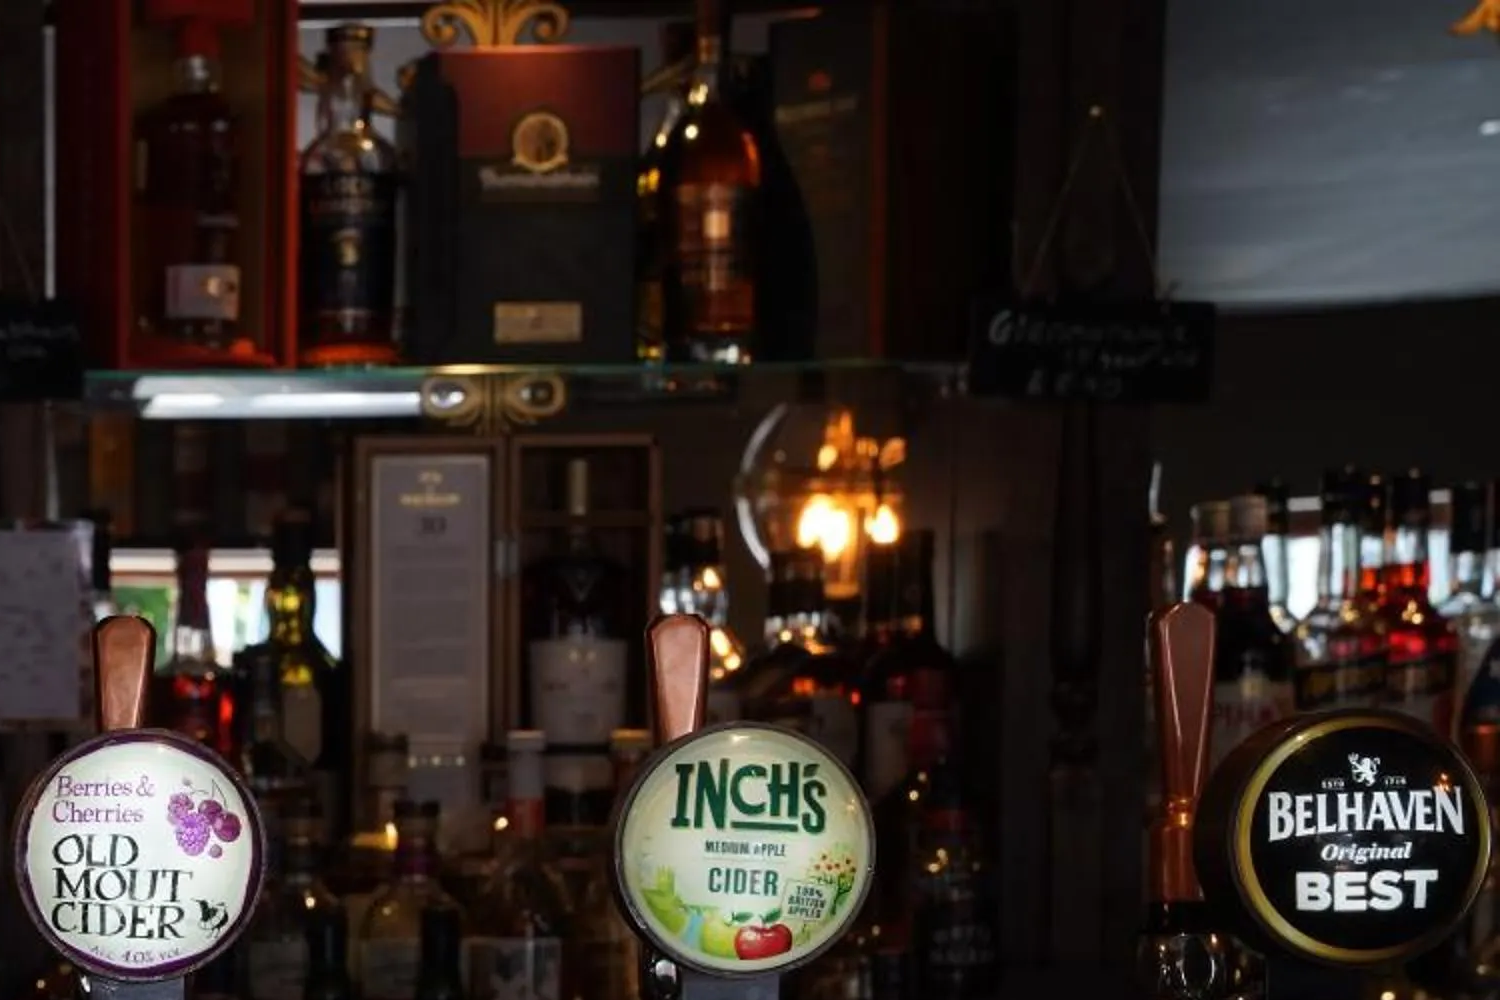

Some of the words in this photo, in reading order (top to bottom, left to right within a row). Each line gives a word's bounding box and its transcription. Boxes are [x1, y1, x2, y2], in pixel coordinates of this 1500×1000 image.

[57, 775, 133, 798] Berries
[135, 775, 156, 798] &
[52, 799, 145, 824] Cherries
[1268, 785, 1467, 843] BELHAVEN
[52, 833, 139, 868] OLD
[705, 839, 750, 855] MEDIUM
[753, 842, 787, 857] APPLE
[1320, 841, 1413, 866] Original
[52, 867, 193, 902] MOUT
[708, 867, 779, 897] CIDER
[1295, 868, 1440, 914] BEST
[51, 901, 185, 940] CIDER
